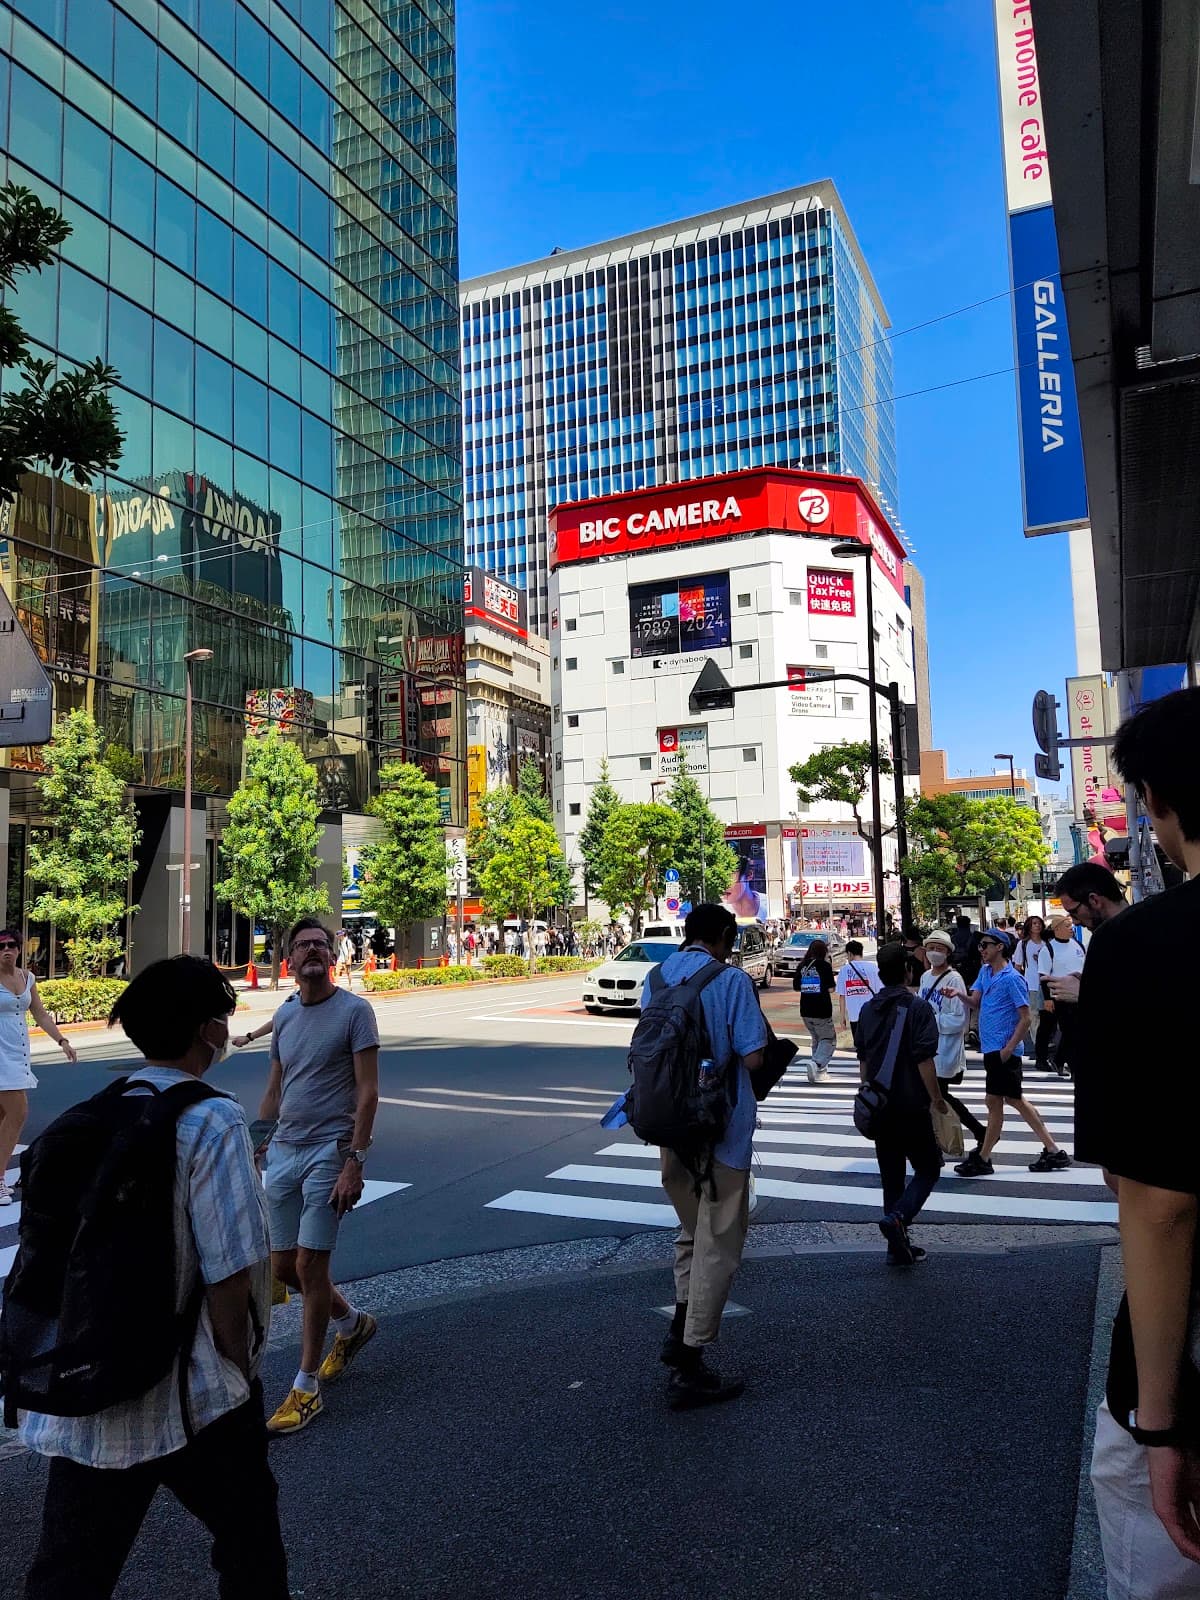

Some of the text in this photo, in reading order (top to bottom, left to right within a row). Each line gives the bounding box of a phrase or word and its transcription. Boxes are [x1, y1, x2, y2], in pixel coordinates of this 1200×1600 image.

[1020, 118, 1049, 180] cafe
[1033, 279, 1063, 454] GALLERIA
[579, 496, 742, 544] BIC CAMERA
[808, 574, 845, 587] QUICK
[809, 584, 852, 598] Tax Free
[810, 598, 852, 612] 快速免税
[634, 620, 671, 639] 1989
[686, 613, 725, 632] 2024
[669, 654, 709, 666] dynabook
[1080, 716, 1093, 773] at-ome
[814, 882, 870, 893] ビックカメラ
